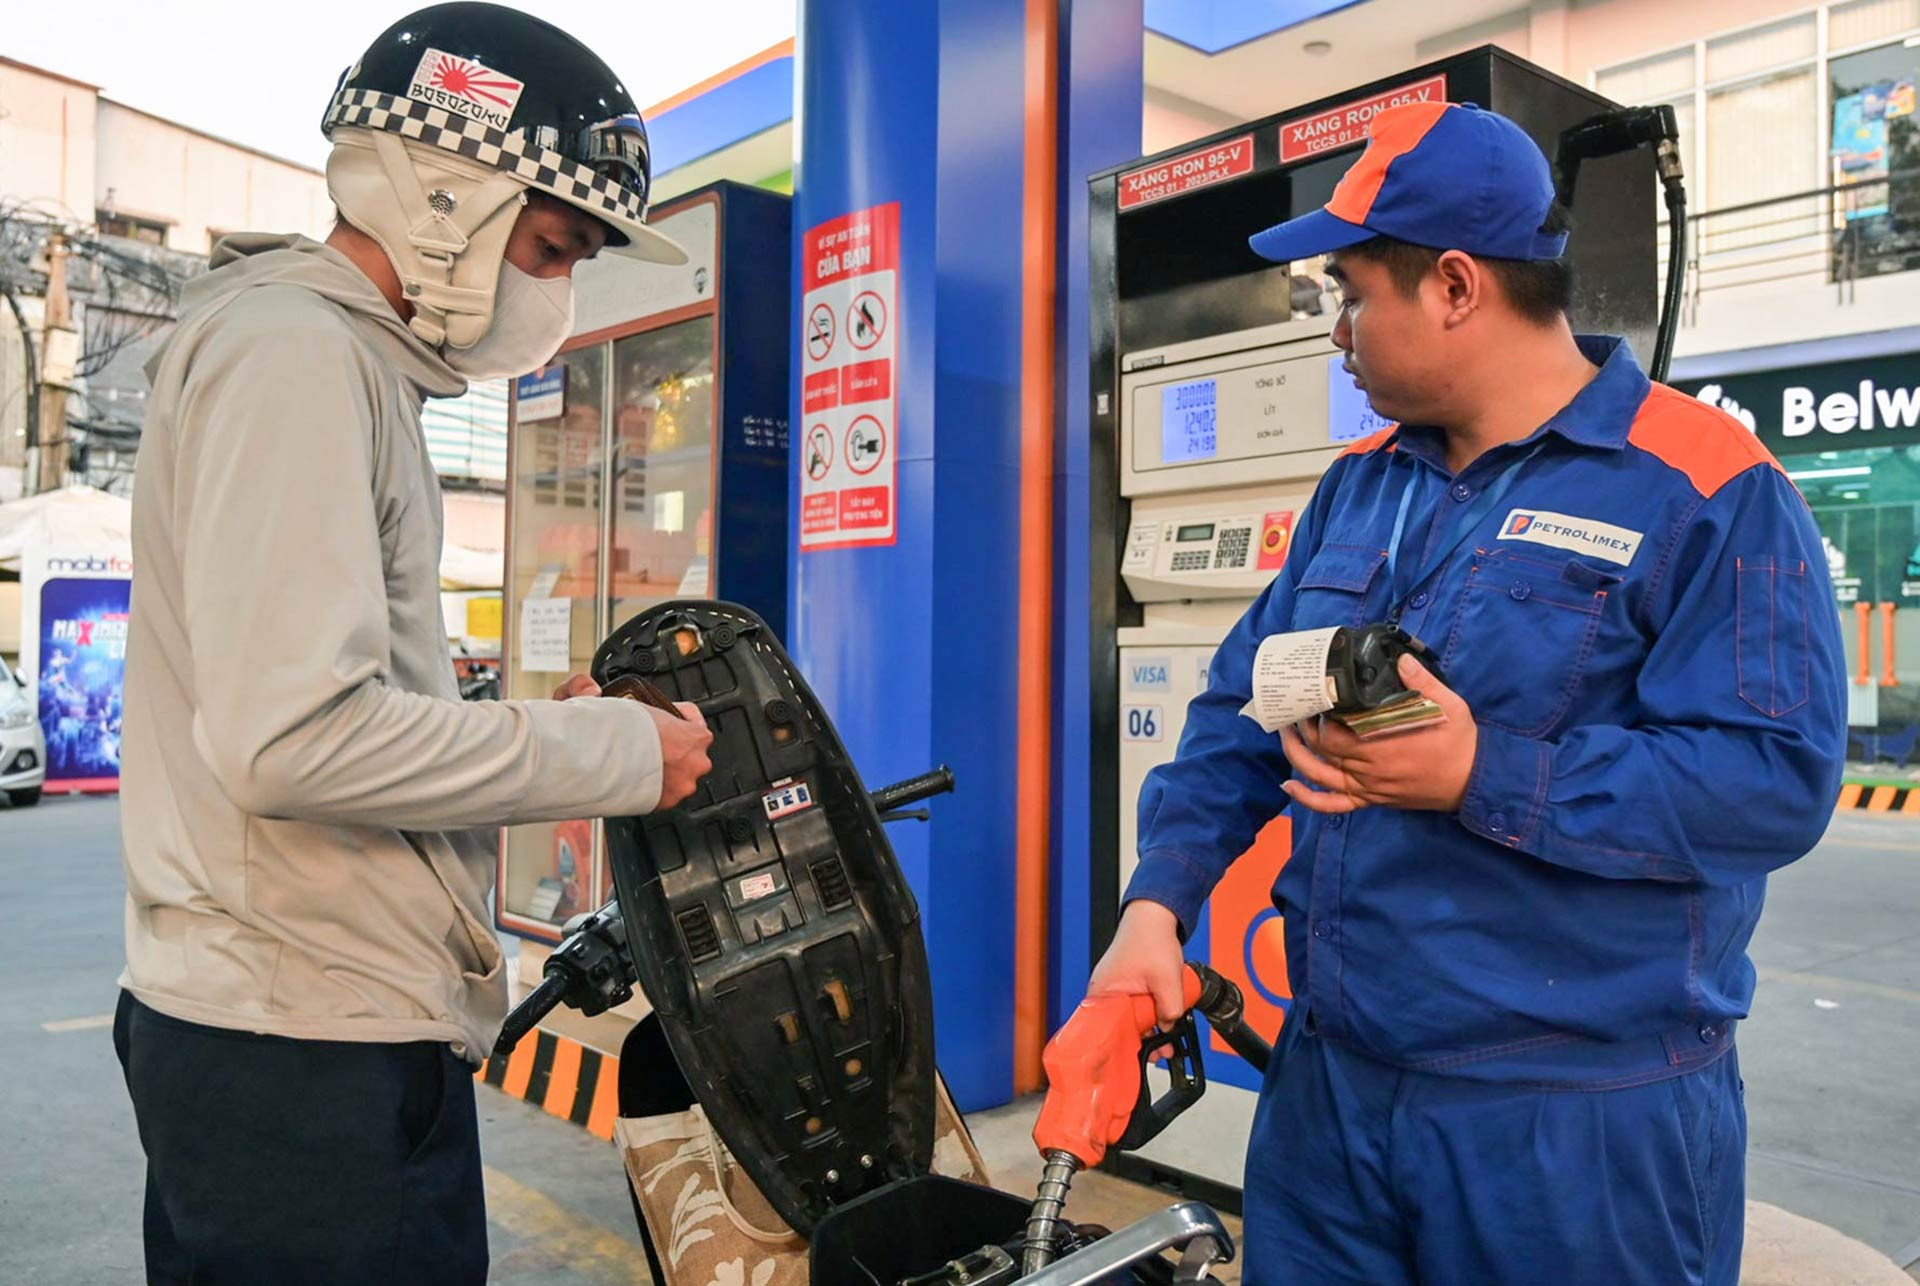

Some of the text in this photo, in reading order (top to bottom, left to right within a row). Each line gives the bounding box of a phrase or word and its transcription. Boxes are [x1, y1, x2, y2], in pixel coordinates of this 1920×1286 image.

[411, 83, 508, 128] BOSOZOKU
[1292, 116, 1341, 142] XĂNG
[1306, 135, 1337, 151] TCCS
[1339, 131, 1351, 142] 01
[1128, 146, 1241, 192] XĂNG RON 95-V
[1139, 186, 1165, 201] TCCS
[1167, 182, 1177, 193] 01
[817, 245, 871, 279] CỦA BẠN
[1532, 521, 1632, 552] PETROLIMEX
[1132, 666, 1167, 683] VISA
[1129, 709, 1156, 737] 06
